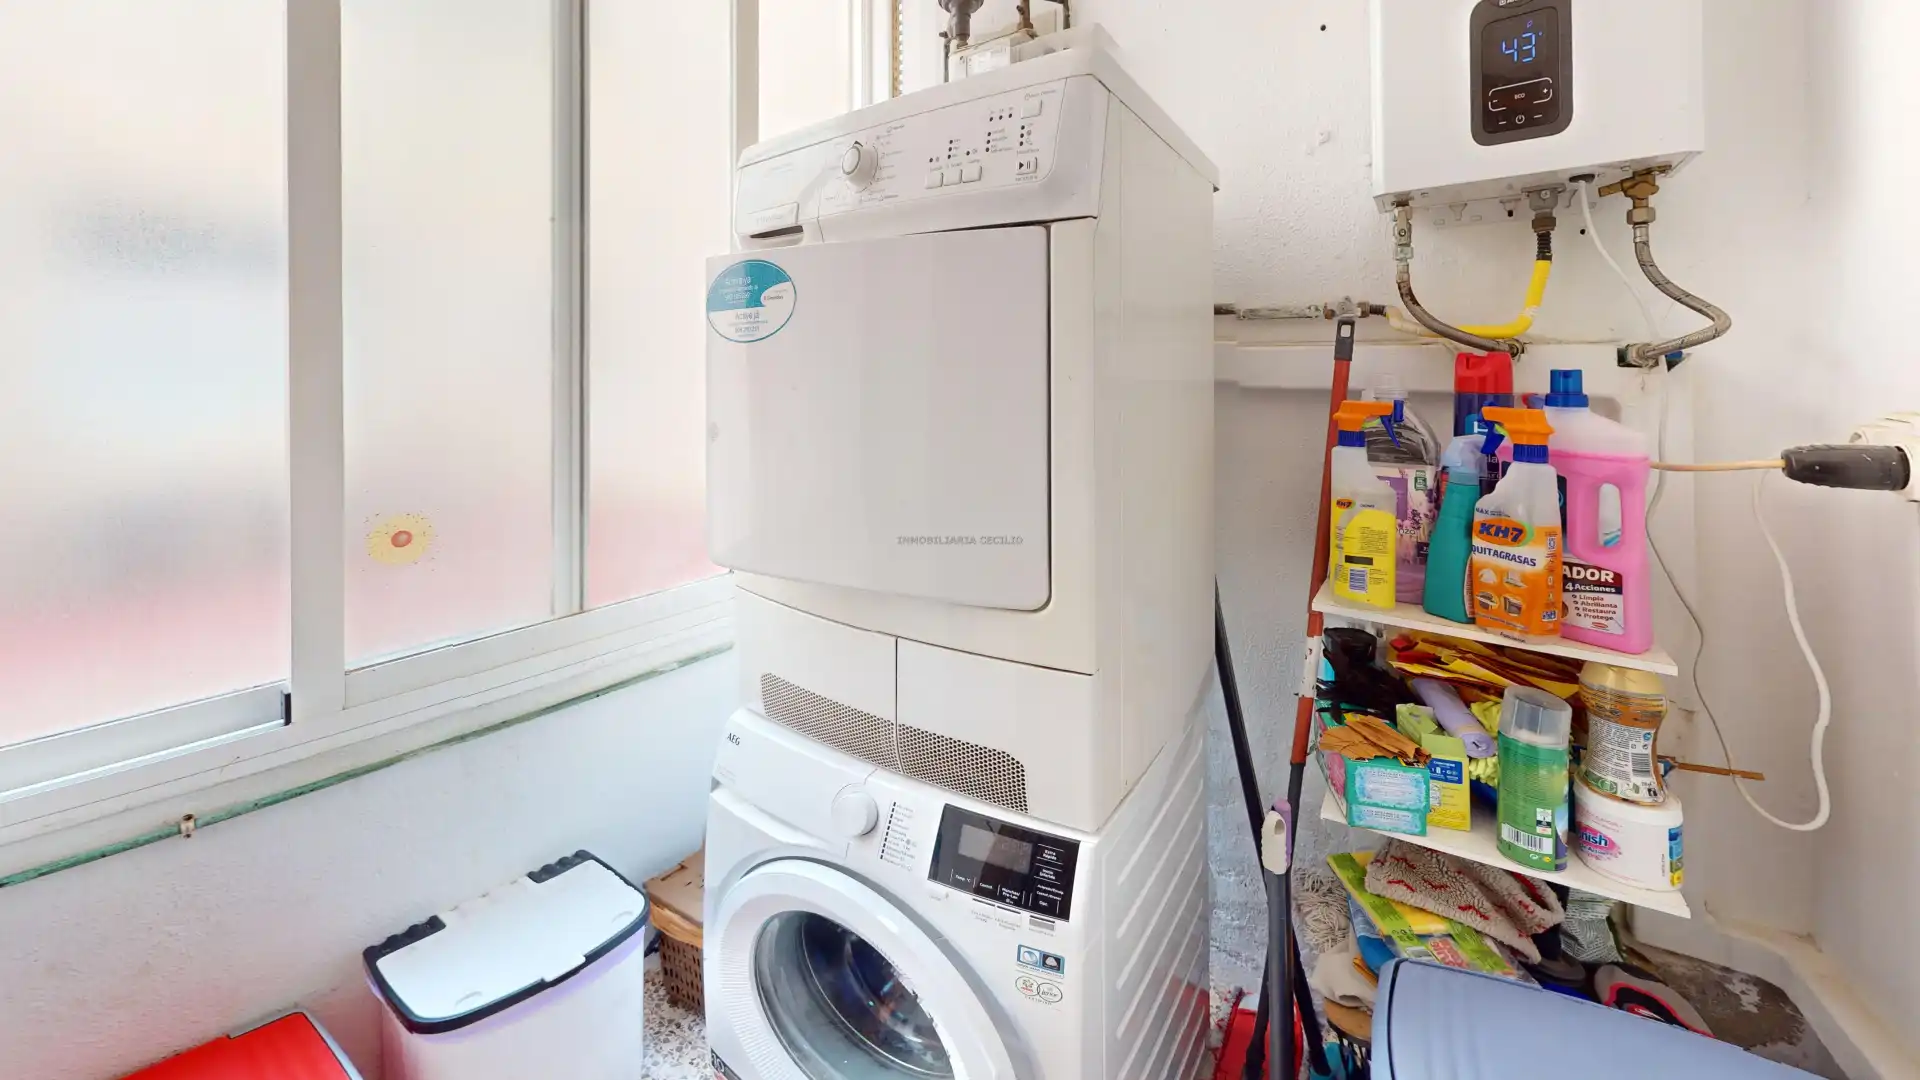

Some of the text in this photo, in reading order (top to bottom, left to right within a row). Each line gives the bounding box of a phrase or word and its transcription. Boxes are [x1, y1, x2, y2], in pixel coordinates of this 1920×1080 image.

[1471, 543, 1538, 568] QUITAGRASAS
[1565, 582, 1617, 593] 4 Acciones
[1579, 594, 1604, 602] Limpia
[1580, 600, 1618, 609] Abrillanta
[1582, 606, 1617, 615] Restaura
[1583, 612, 1615, 621] Protege
[727, 732, 741, 746] AEG
